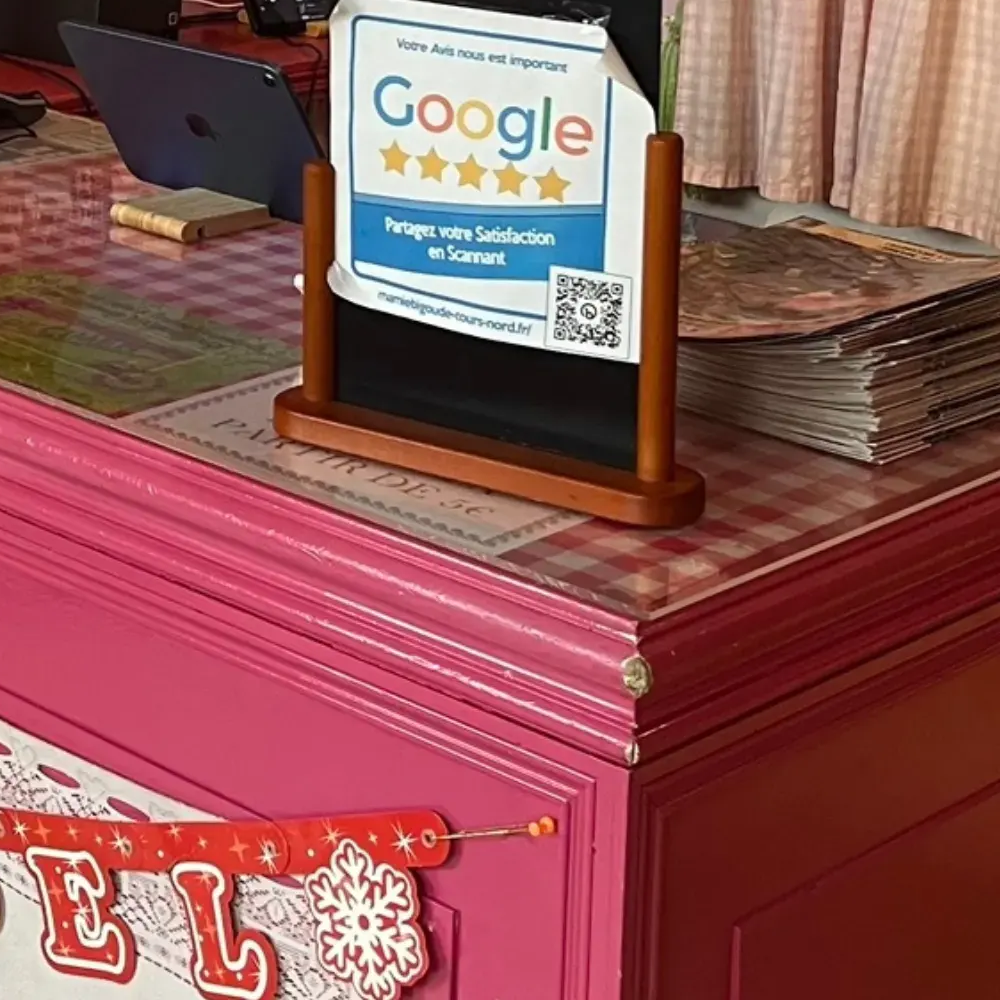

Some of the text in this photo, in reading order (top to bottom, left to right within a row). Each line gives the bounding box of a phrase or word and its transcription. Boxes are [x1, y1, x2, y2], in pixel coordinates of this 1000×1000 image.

[396, 38, 568, 73] Votre Avis nous est important
[373, 75, 594, 162] Google
[384, 216, 556, 246] Partagez votre Satisfaction
[427, 245, 507, 266] en Scannant
[368, 471, 441, 501] DE
